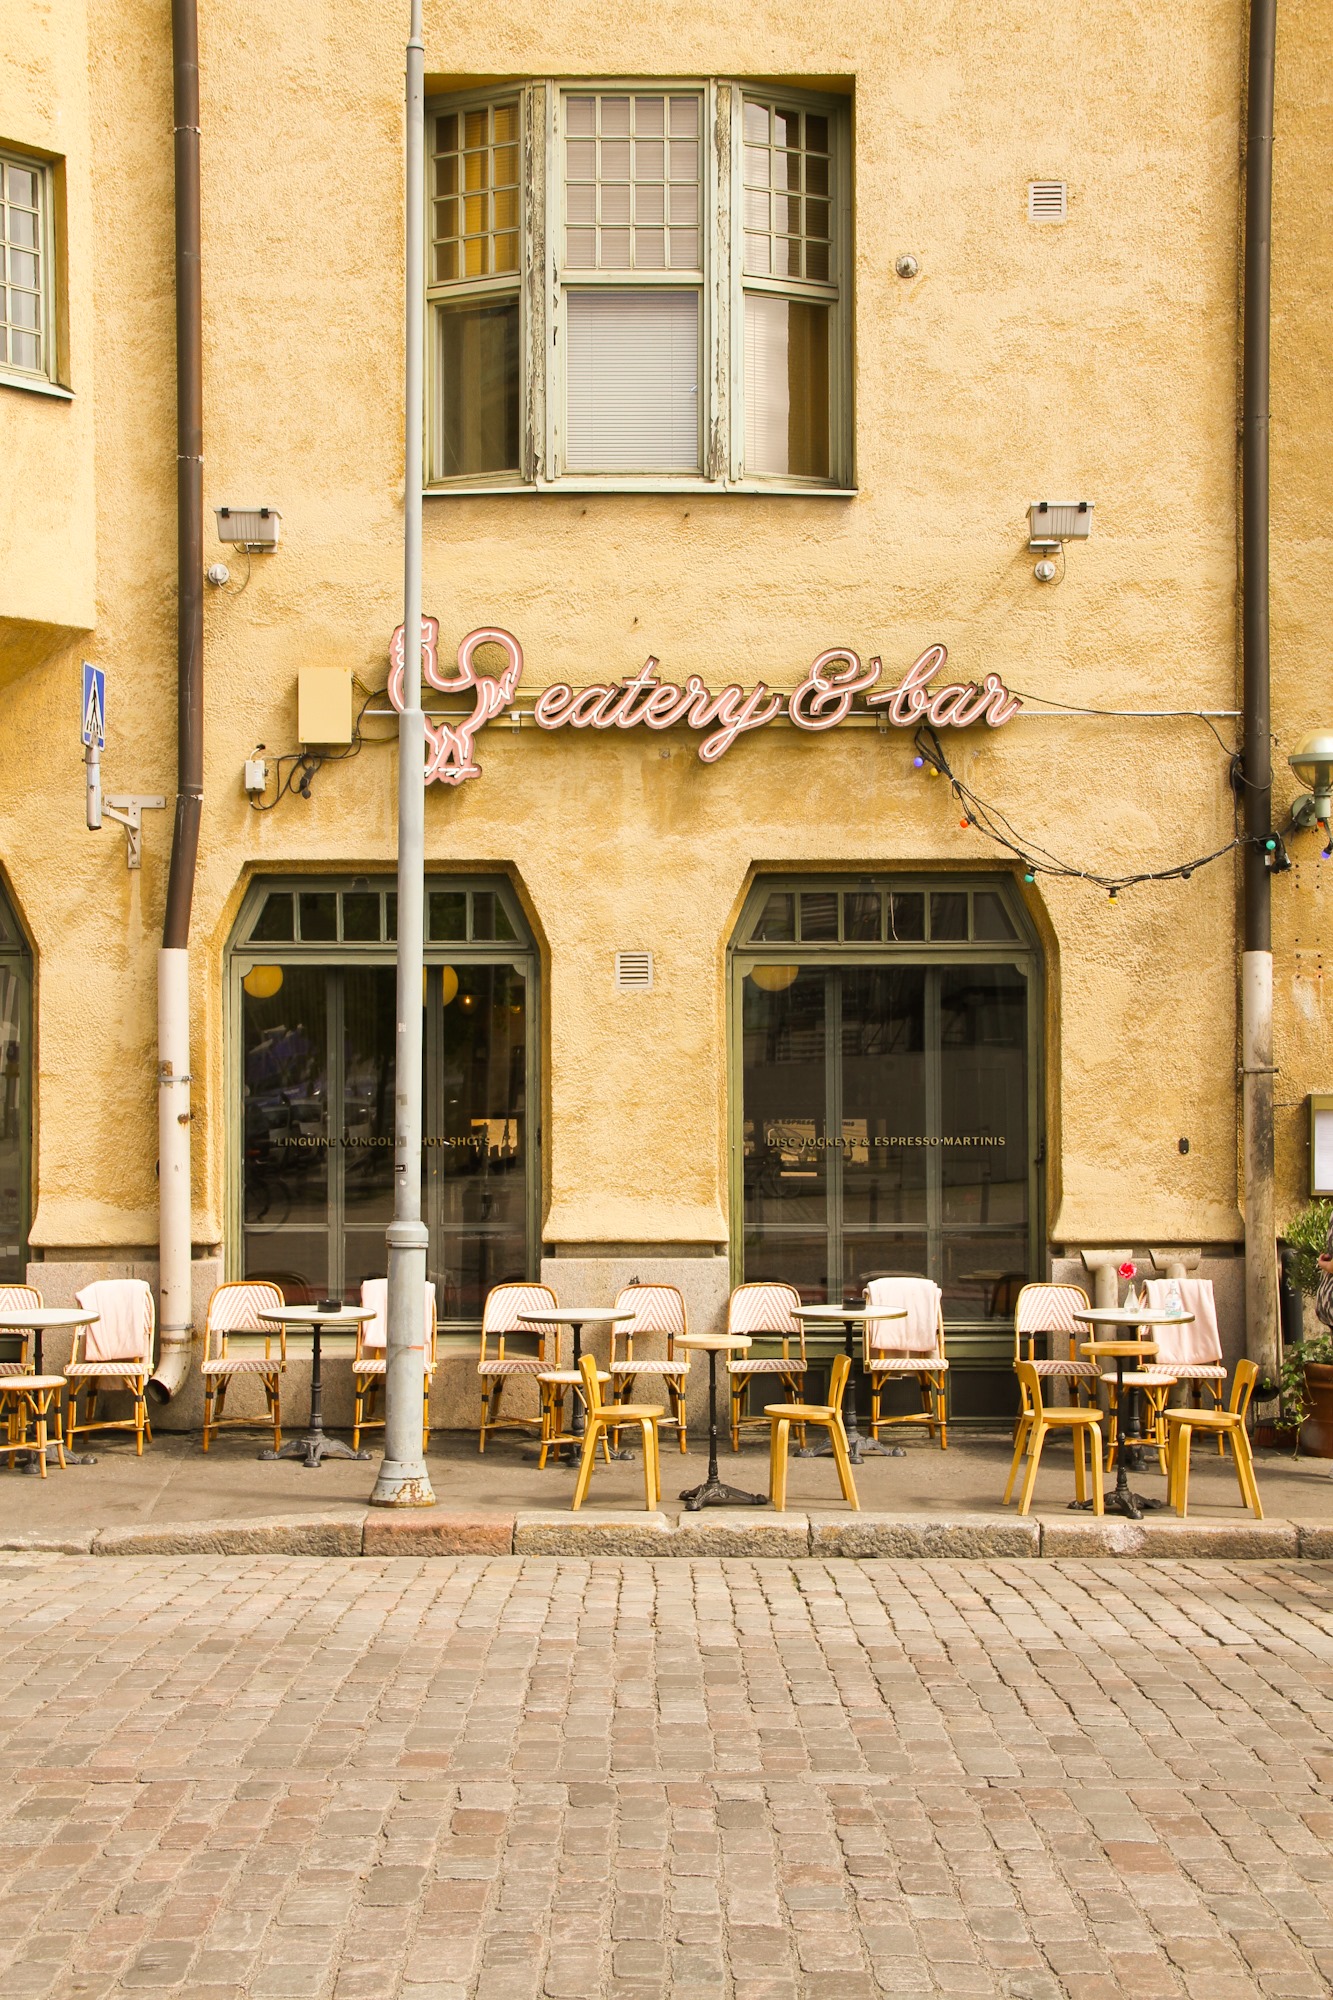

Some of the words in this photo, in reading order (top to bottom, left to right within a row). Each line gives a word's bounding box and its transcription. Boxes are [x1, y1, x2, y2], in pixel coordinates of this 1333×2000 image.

[533, 655, 784, 763] eatery
[789, 646, 882, 730] &
[866, 643, 1024, 729] bar
[277, 1137, 338, 1147] LINGUINE
[341, 1137, 394, 1147] VONGOL
[449, 1136, 490, 1147] SHOTS
[767, 1137, 797, 1147] DISC
[800, 1137, 858, 1147] JOCKEYS
[861, 1137, 871, 1147] &
[874, 1136, 940, 1146] ESPRESSO
[943, 1136, 1006, 1146] MARTINIS
